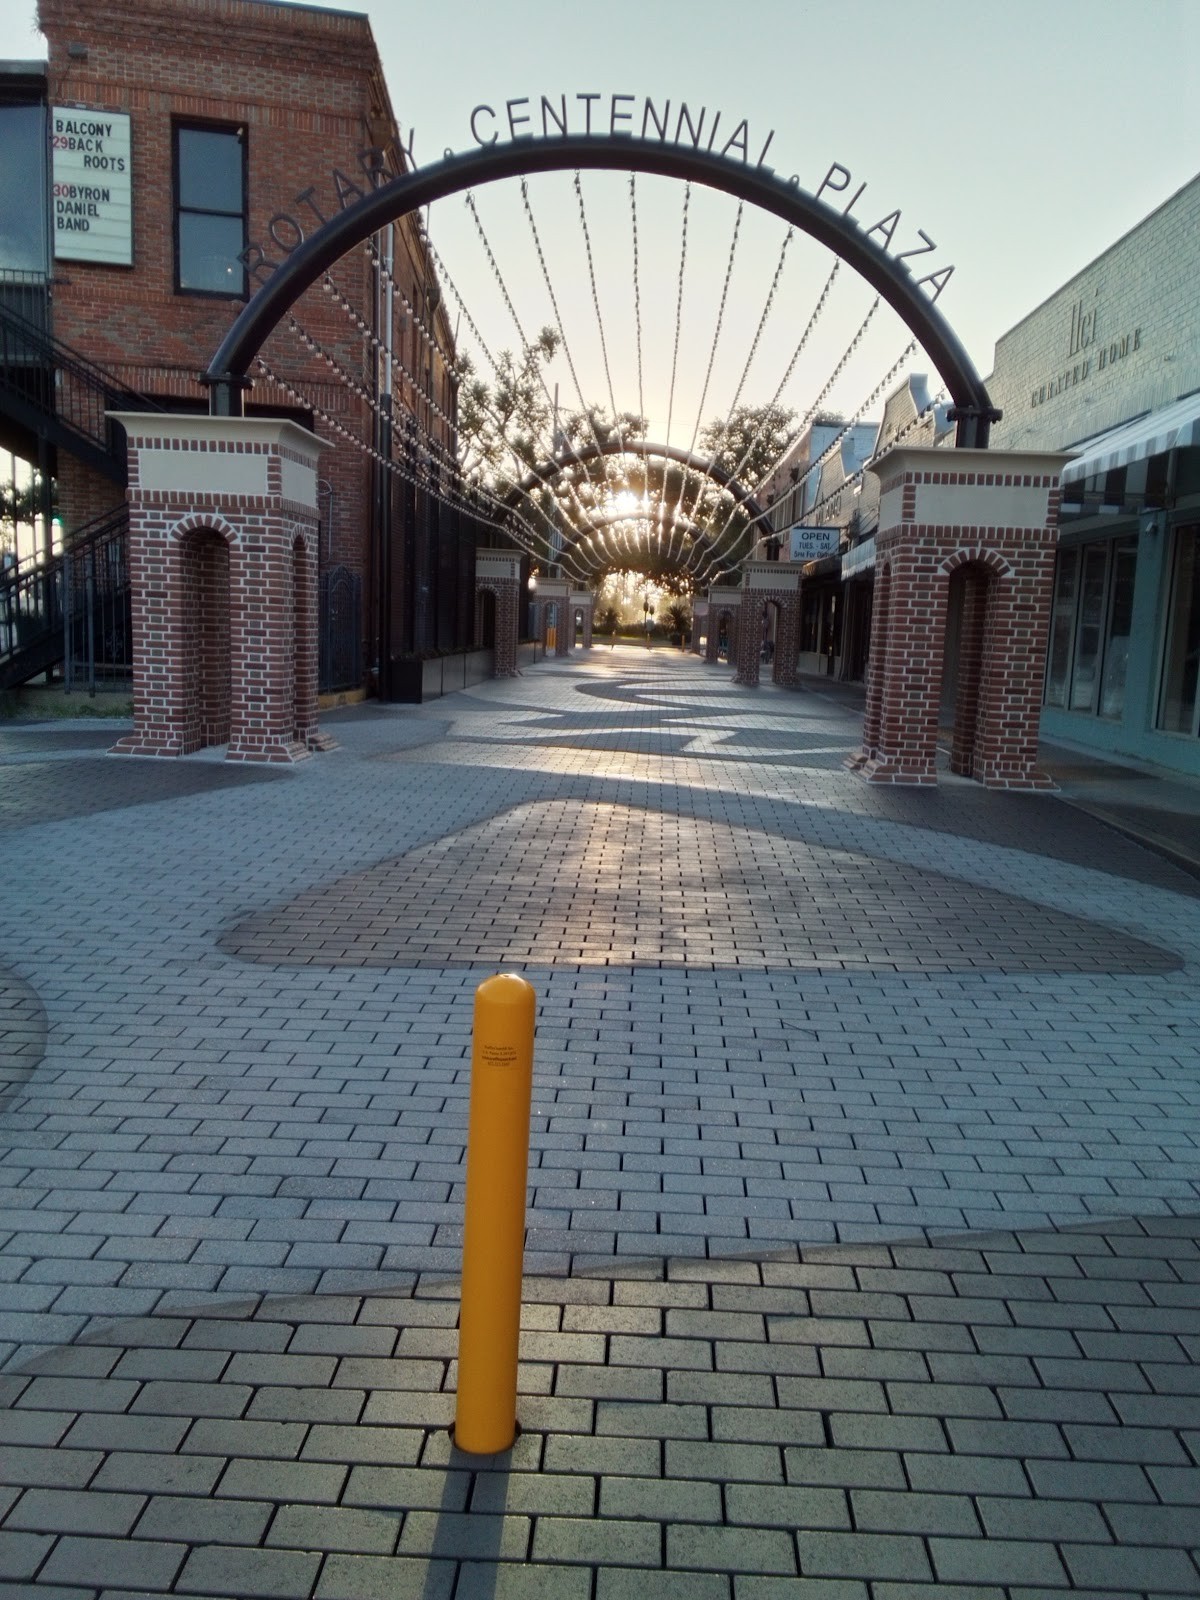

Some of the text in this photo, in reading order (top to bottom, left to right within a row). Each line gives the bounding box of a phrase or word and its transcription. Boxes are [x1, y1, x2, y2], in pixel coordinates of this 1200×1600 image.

[56, 119, 112, 137] BALCONY
[83, 155, 125, 171] ROOTS
[236, 92, 956, 305] ROTARY CENTENNIAL PLAZA
[57, 201, 100, 217] DANIEL
[57, 217, 90, 232] BAND
[1031, 327, 1141, 408] CURATED HOME
[801, 532, 830, 541] OPEN
